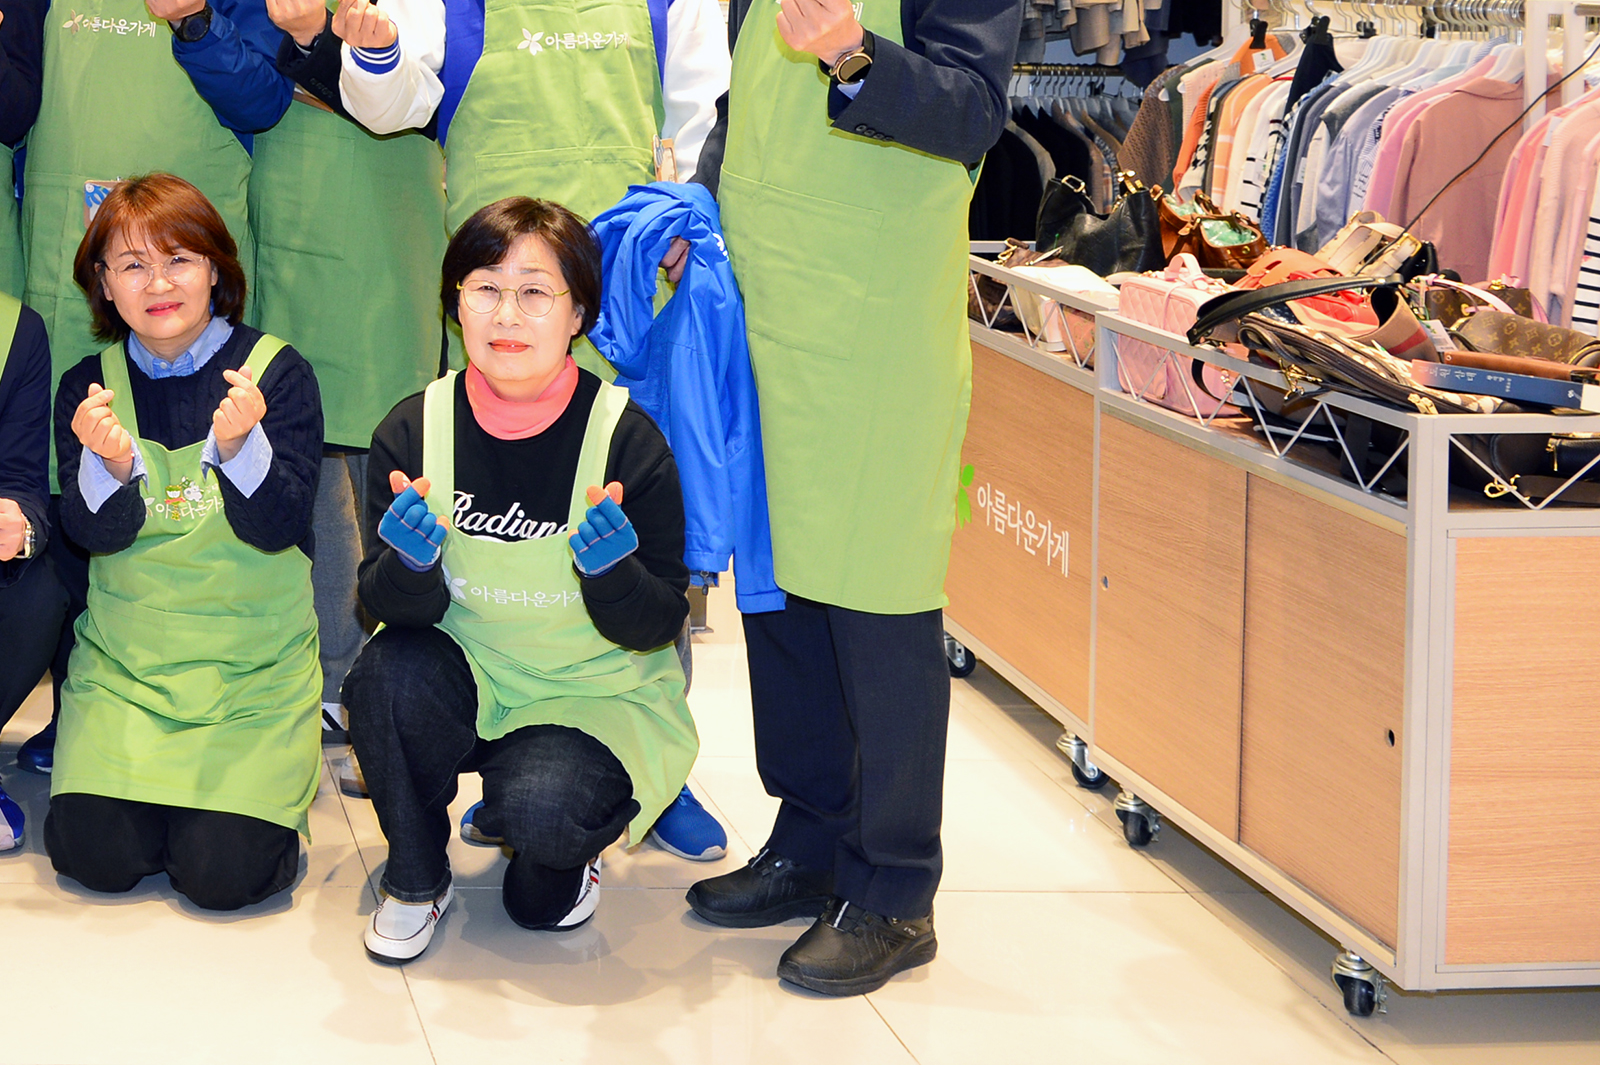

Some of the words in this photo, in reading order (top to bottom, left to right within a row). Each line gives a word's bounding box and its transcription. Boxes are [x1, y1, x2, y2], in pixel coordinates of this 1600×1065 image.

[82, 16, 157, 38] 아름다운가게
[545, 31, 631, 51] 아름다운가게
[155, 495, 225, 520] 아다운가
[977, 482, 1070, 578] 아름다운가게
